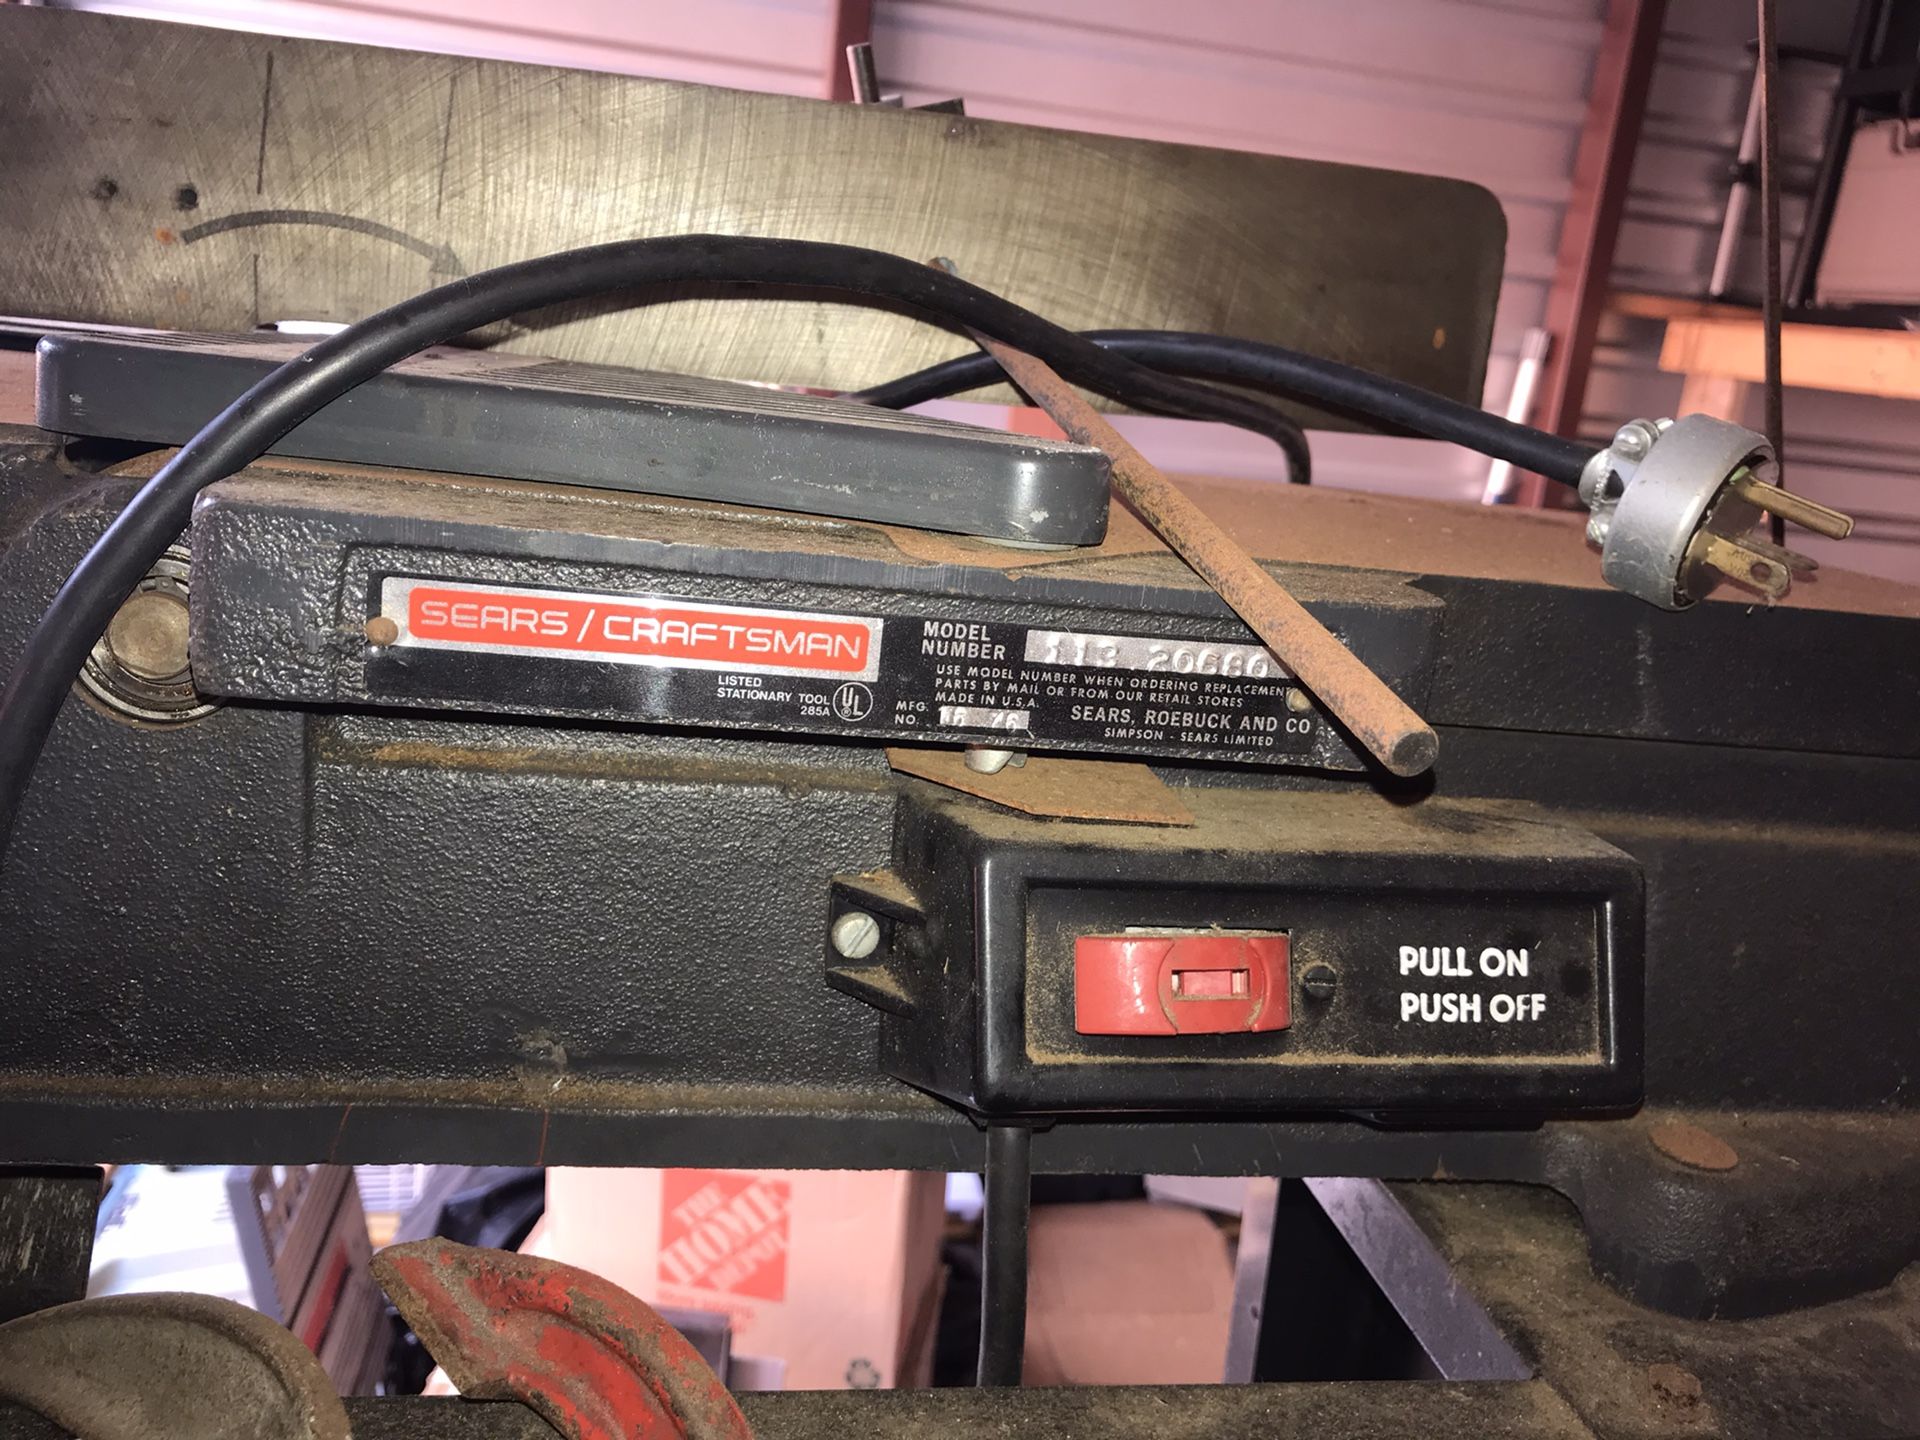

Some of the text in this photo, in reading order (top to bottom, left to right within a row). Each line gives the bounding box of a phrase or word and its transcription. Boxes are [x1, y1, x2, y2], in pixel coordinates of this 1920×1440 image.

[923, 620, 991, 641] MODEL
[921, 639, 1006, 661] NUMBER
[718, 675, 762, 688] LISTED
[936, 664, 961, 676] USE
[967, 666, 1014, 680] MODEL
[1020, 670, 1076, 684] NUMBER
[1084, 674, 1123, 687] WHEN
[1130, 678, 1199, 692] ORDERING
[717, 687, 831, 706] STATIONARY TOOL
[935, 677, 1244, 708] PARTS BY MAIL OR FROM OUR RETAIL STORES
[935, 691, 975, 704] MADE
[981, 694, 995, 706] IN
[800, 706, 831, 717] 285A
[896, 701, 929, 712] MFG.
[894, 713, 920, 725] NO.
[1070, 705, 1311, 734] SEARS, ROEBUCK AND CO
[1104, 727, 1164, 740] SIMPSON
[1180, 732, 1219, 744] SEARS
[1224, 734, 1274, 746] LIMITED
[1399, 945, 1529, 977] PULL ON
[1400, 992, 1547, 1023] PUSH OFF
[671, 1179, 723, 1227] THE
[659, 1175, 792, 1286] HOME
